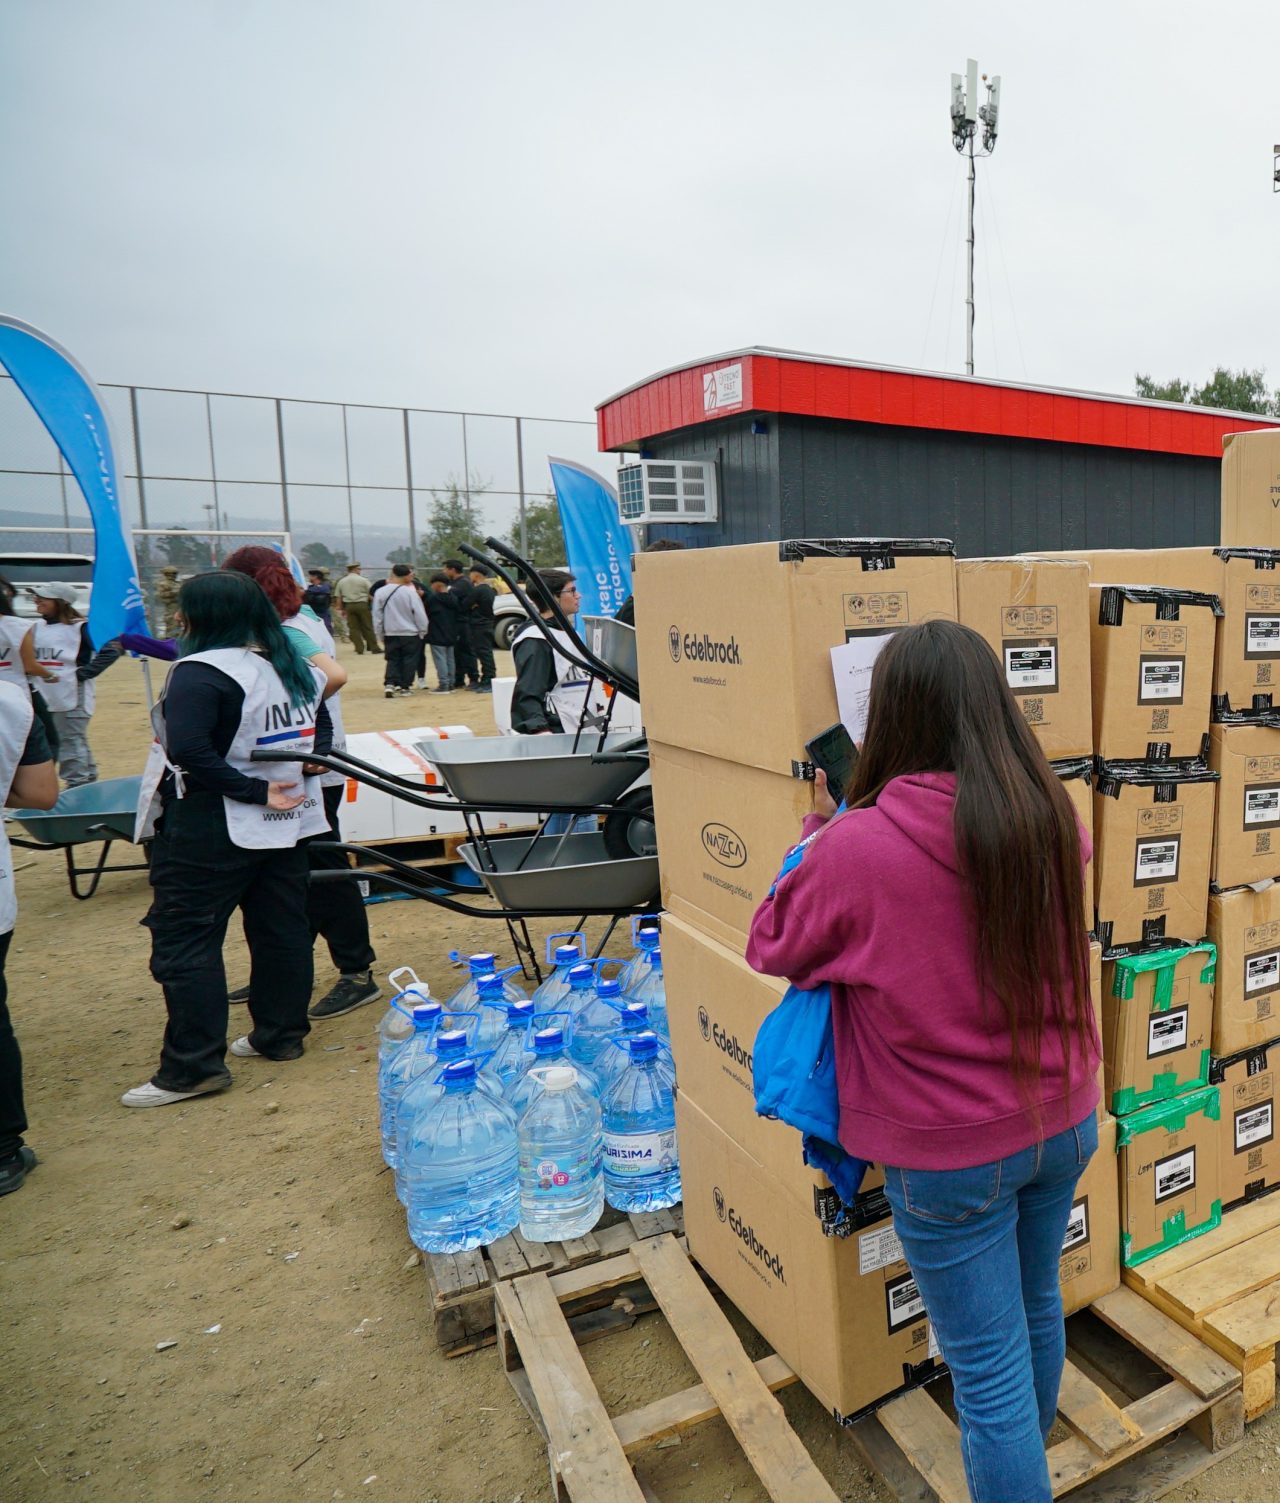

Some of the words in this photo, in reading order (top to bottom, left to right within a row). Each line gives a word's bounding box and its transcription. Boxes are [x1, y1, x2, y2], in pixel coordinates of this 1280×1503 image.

[683, 633, 740, 665] Edelbrock
[706, 831, 743, 859] NAZCA
[728, 1207, 785, 1284] Edelbrock
